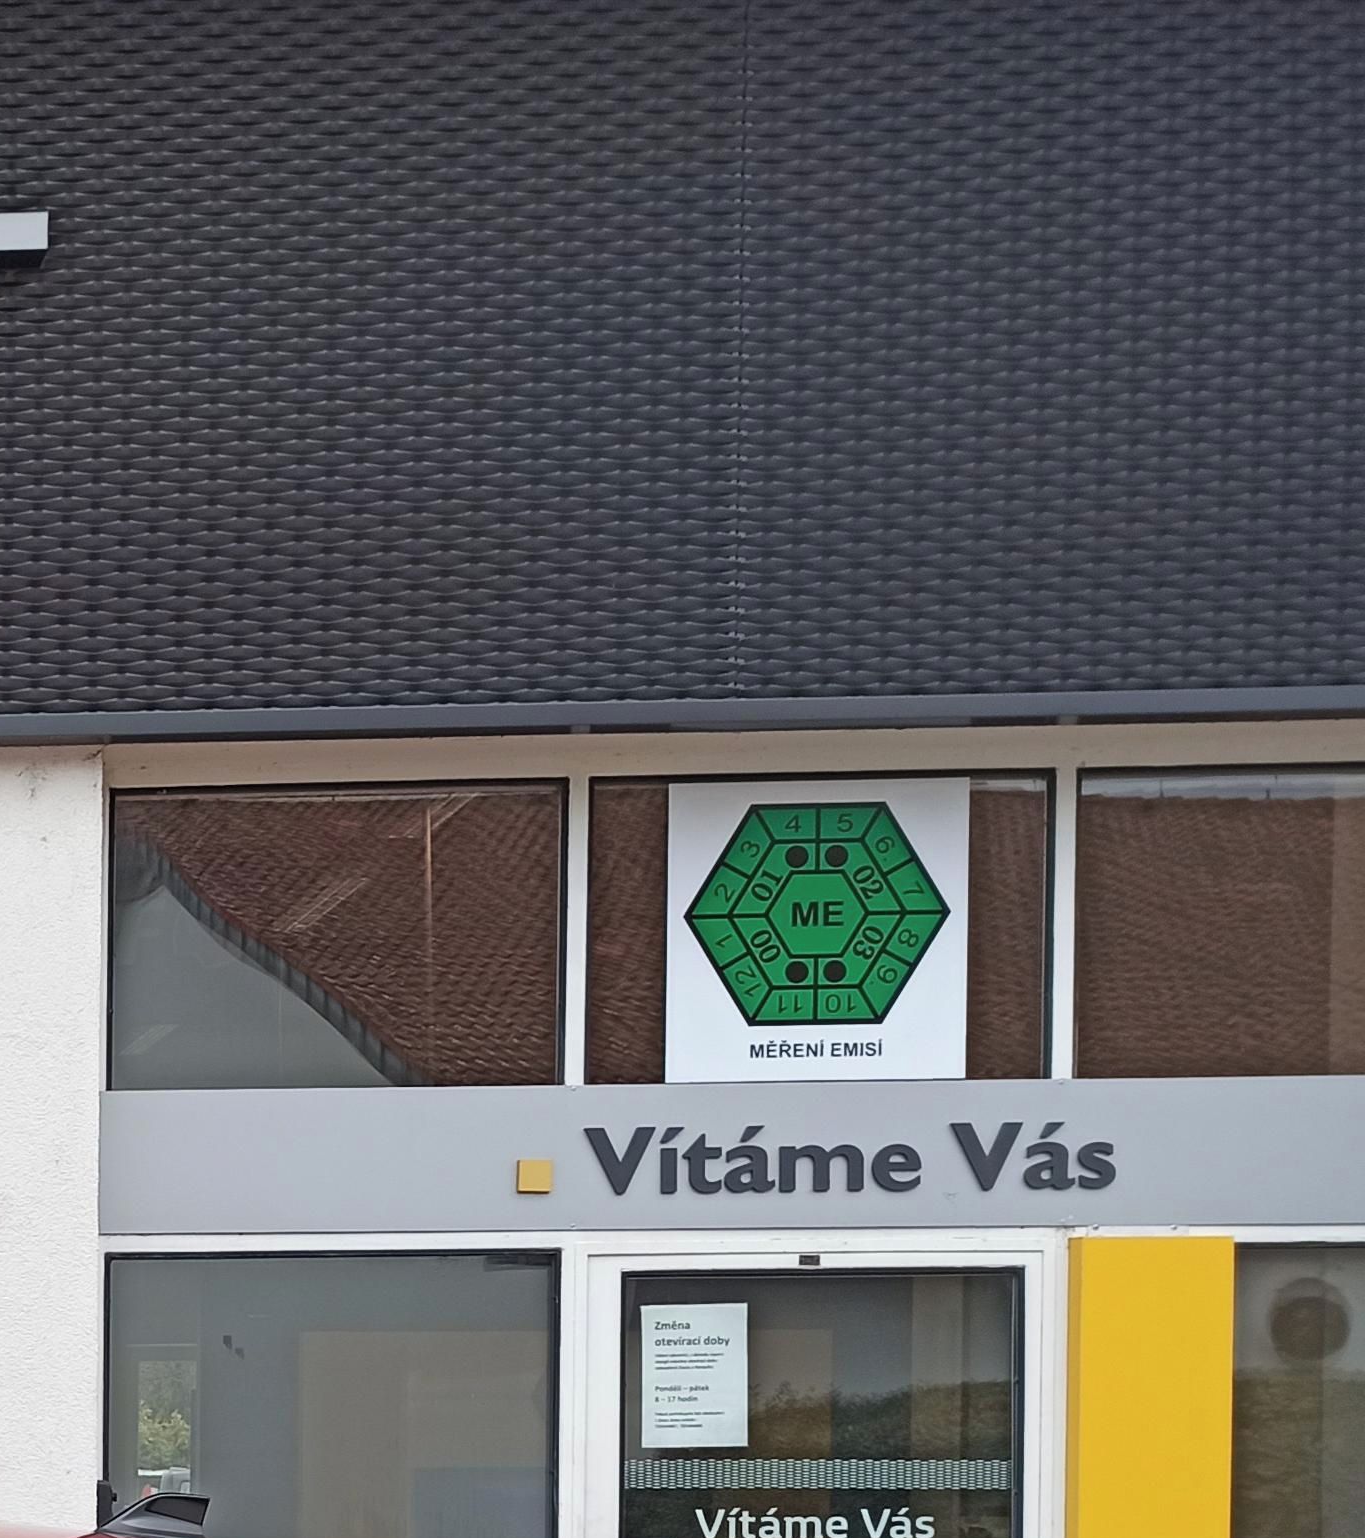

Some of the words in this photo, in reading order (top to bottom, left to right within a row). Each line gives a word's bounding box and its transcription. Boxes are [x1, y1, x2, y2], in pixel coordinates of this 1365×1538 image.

[784, 814, 802, 833] 4
[837, 813, 854, 832] 5
[740, 840, 761, 859] 3
[714, 882, 736, 903] 2
[750, 869, 784, 902] 01
[852, 864, 884, 900] 02
[902, 882, 924, 897] 7
[791, 901, 844, 927] ME
[715, 933, 733, 948] 1
[750, 929, 781, 963] 00
[852, 925, 884, 961] 03
[897, 927, 920, 948] 8
[734, 964, 762, 998] 12
[777, 994, 803, 1014] 11
[824, 994, 857, 1014] 10
[749, 1040, 824, 1059] MĚŘENÍ
[830, 1038, 883, 1057] EMISÍ
[583, 1125, 923, 1195] Vítáme
[948, 1121, 1117, 1192] Vás
[654, 1320, 691, 1330] Změna
[654, 1336, 701, 1346] otevírací
[703, 1336, 730, 1346] doby
